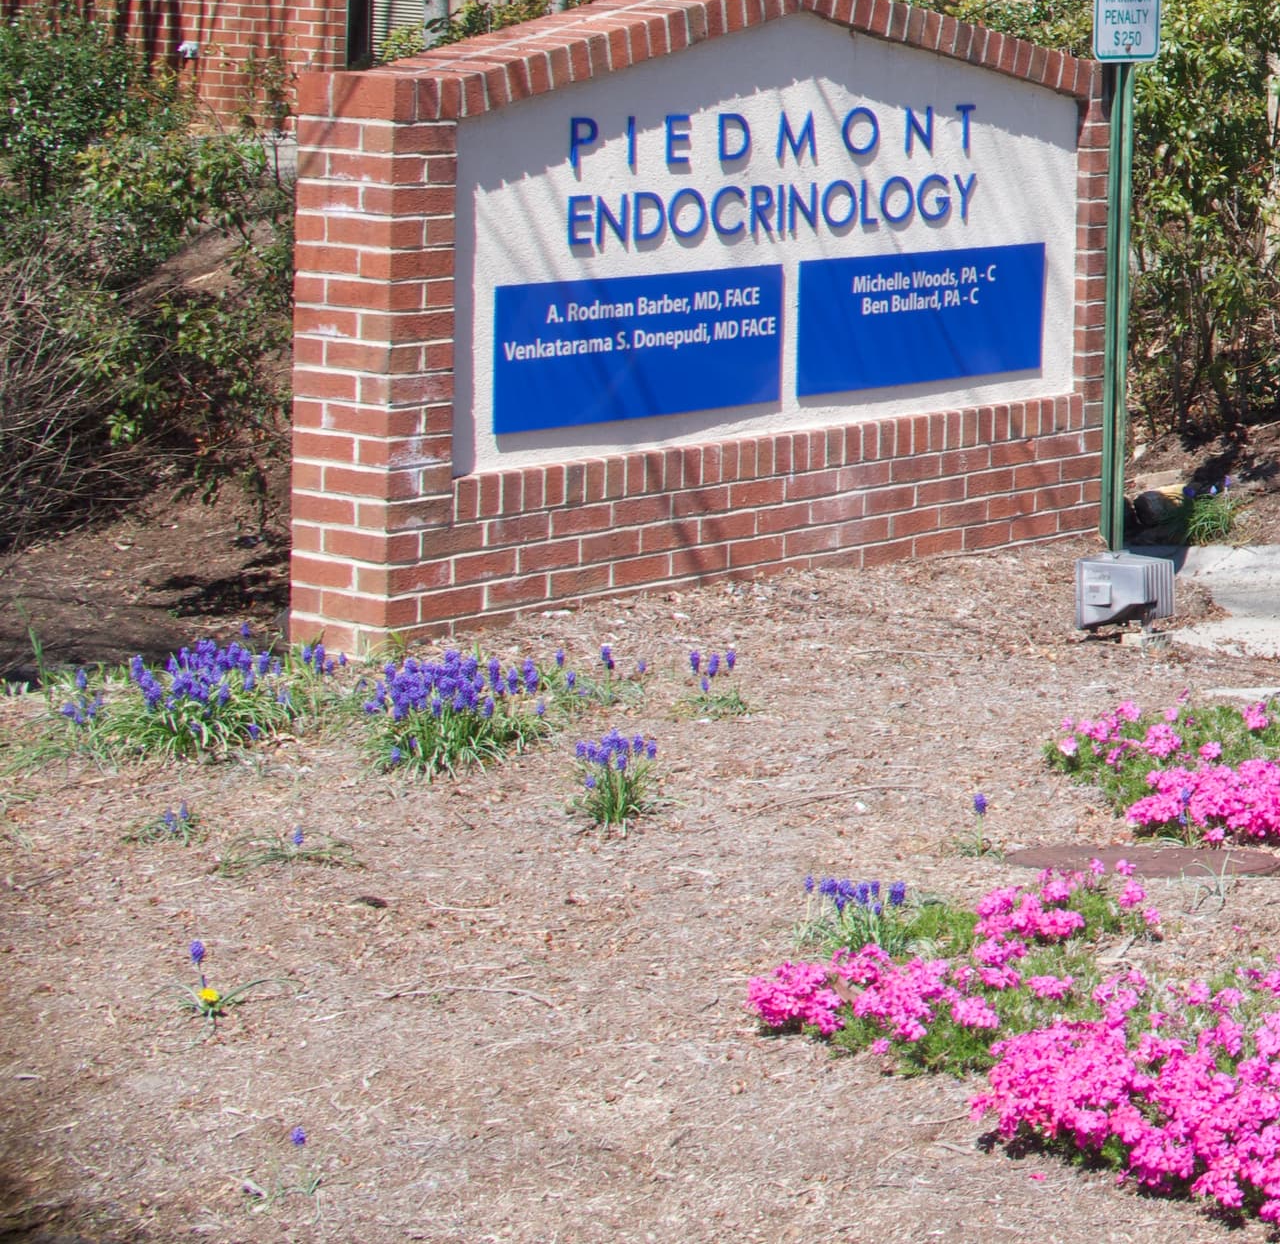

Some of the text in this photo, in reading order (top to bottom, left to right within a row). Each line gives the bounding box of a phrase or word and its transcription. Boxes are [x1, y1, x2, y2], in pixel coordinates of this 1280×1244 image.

[1104, 8, 1149, 25] PENALTY
[1114, 30, 1142, 47] $250
[569, 103, 977, 169] PIEDMONT
[567, 172, 977, 247] ENDOCRINOLOGY
[852, 271, 911, 294] Michelle
[912, 267, 959, 288] Woods,
[546, 287, 760, 324] A. Rodman Barber, MD, FACE
[862, 296, 889, 315] Ben
[891, 290, 942, 313] Bullard,
[504, 316, 776, 361] Venkatarama S. Donepudi, MD FACE
